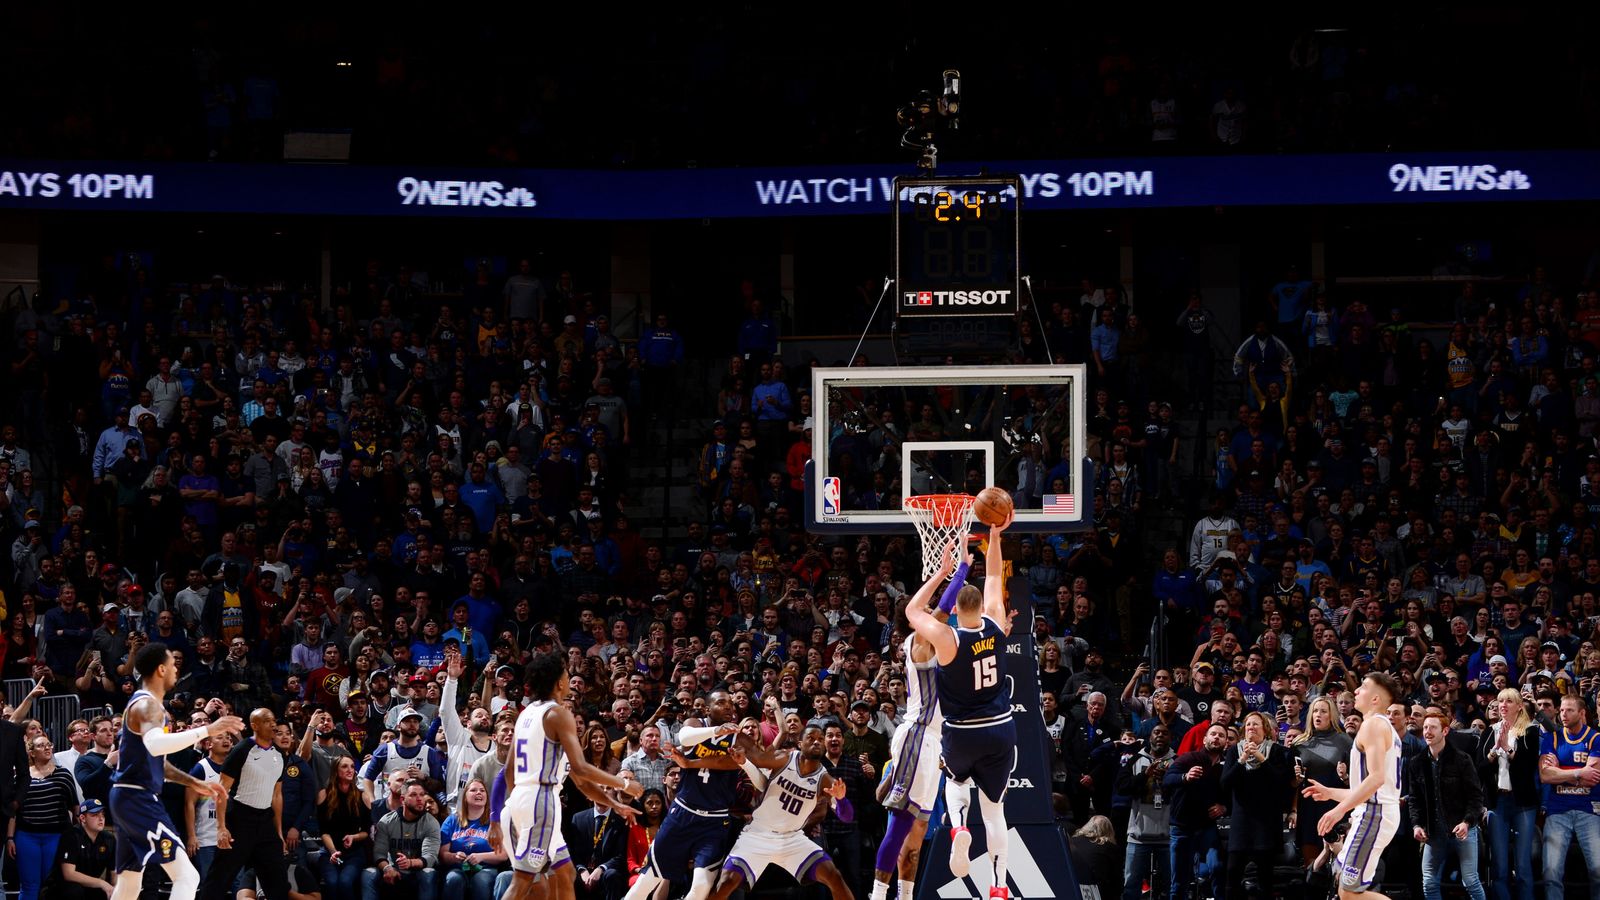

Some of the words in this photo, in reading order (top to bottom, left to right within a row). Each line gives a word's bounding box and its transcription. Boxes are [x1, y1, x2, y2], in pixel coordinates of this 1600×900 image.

[67, 173, 154, 199] 10PM
[755, 177, 873, 204] WATCH
[1066, 171, 1153, 197] 10PM
[1388, 163, 1497, 192] 9NEWS
[397, 176, 504, 207] 9NEWS
[935, 191, 981, 222] 2.4
[933, 290, 1011, 305] TISSOT
[1213, 538, 1223, 548] 15
[972, 654, 998, 691] 15
[516, 739, 528, 774] 5
[1573, 751, 1589, 764] 55
[698, 768, 711, 784] 4
[776, 775, 817, 800] KINGS
[1556, 785, 1592, 796] Nuggets
[778, 791, 804, 816] 40
